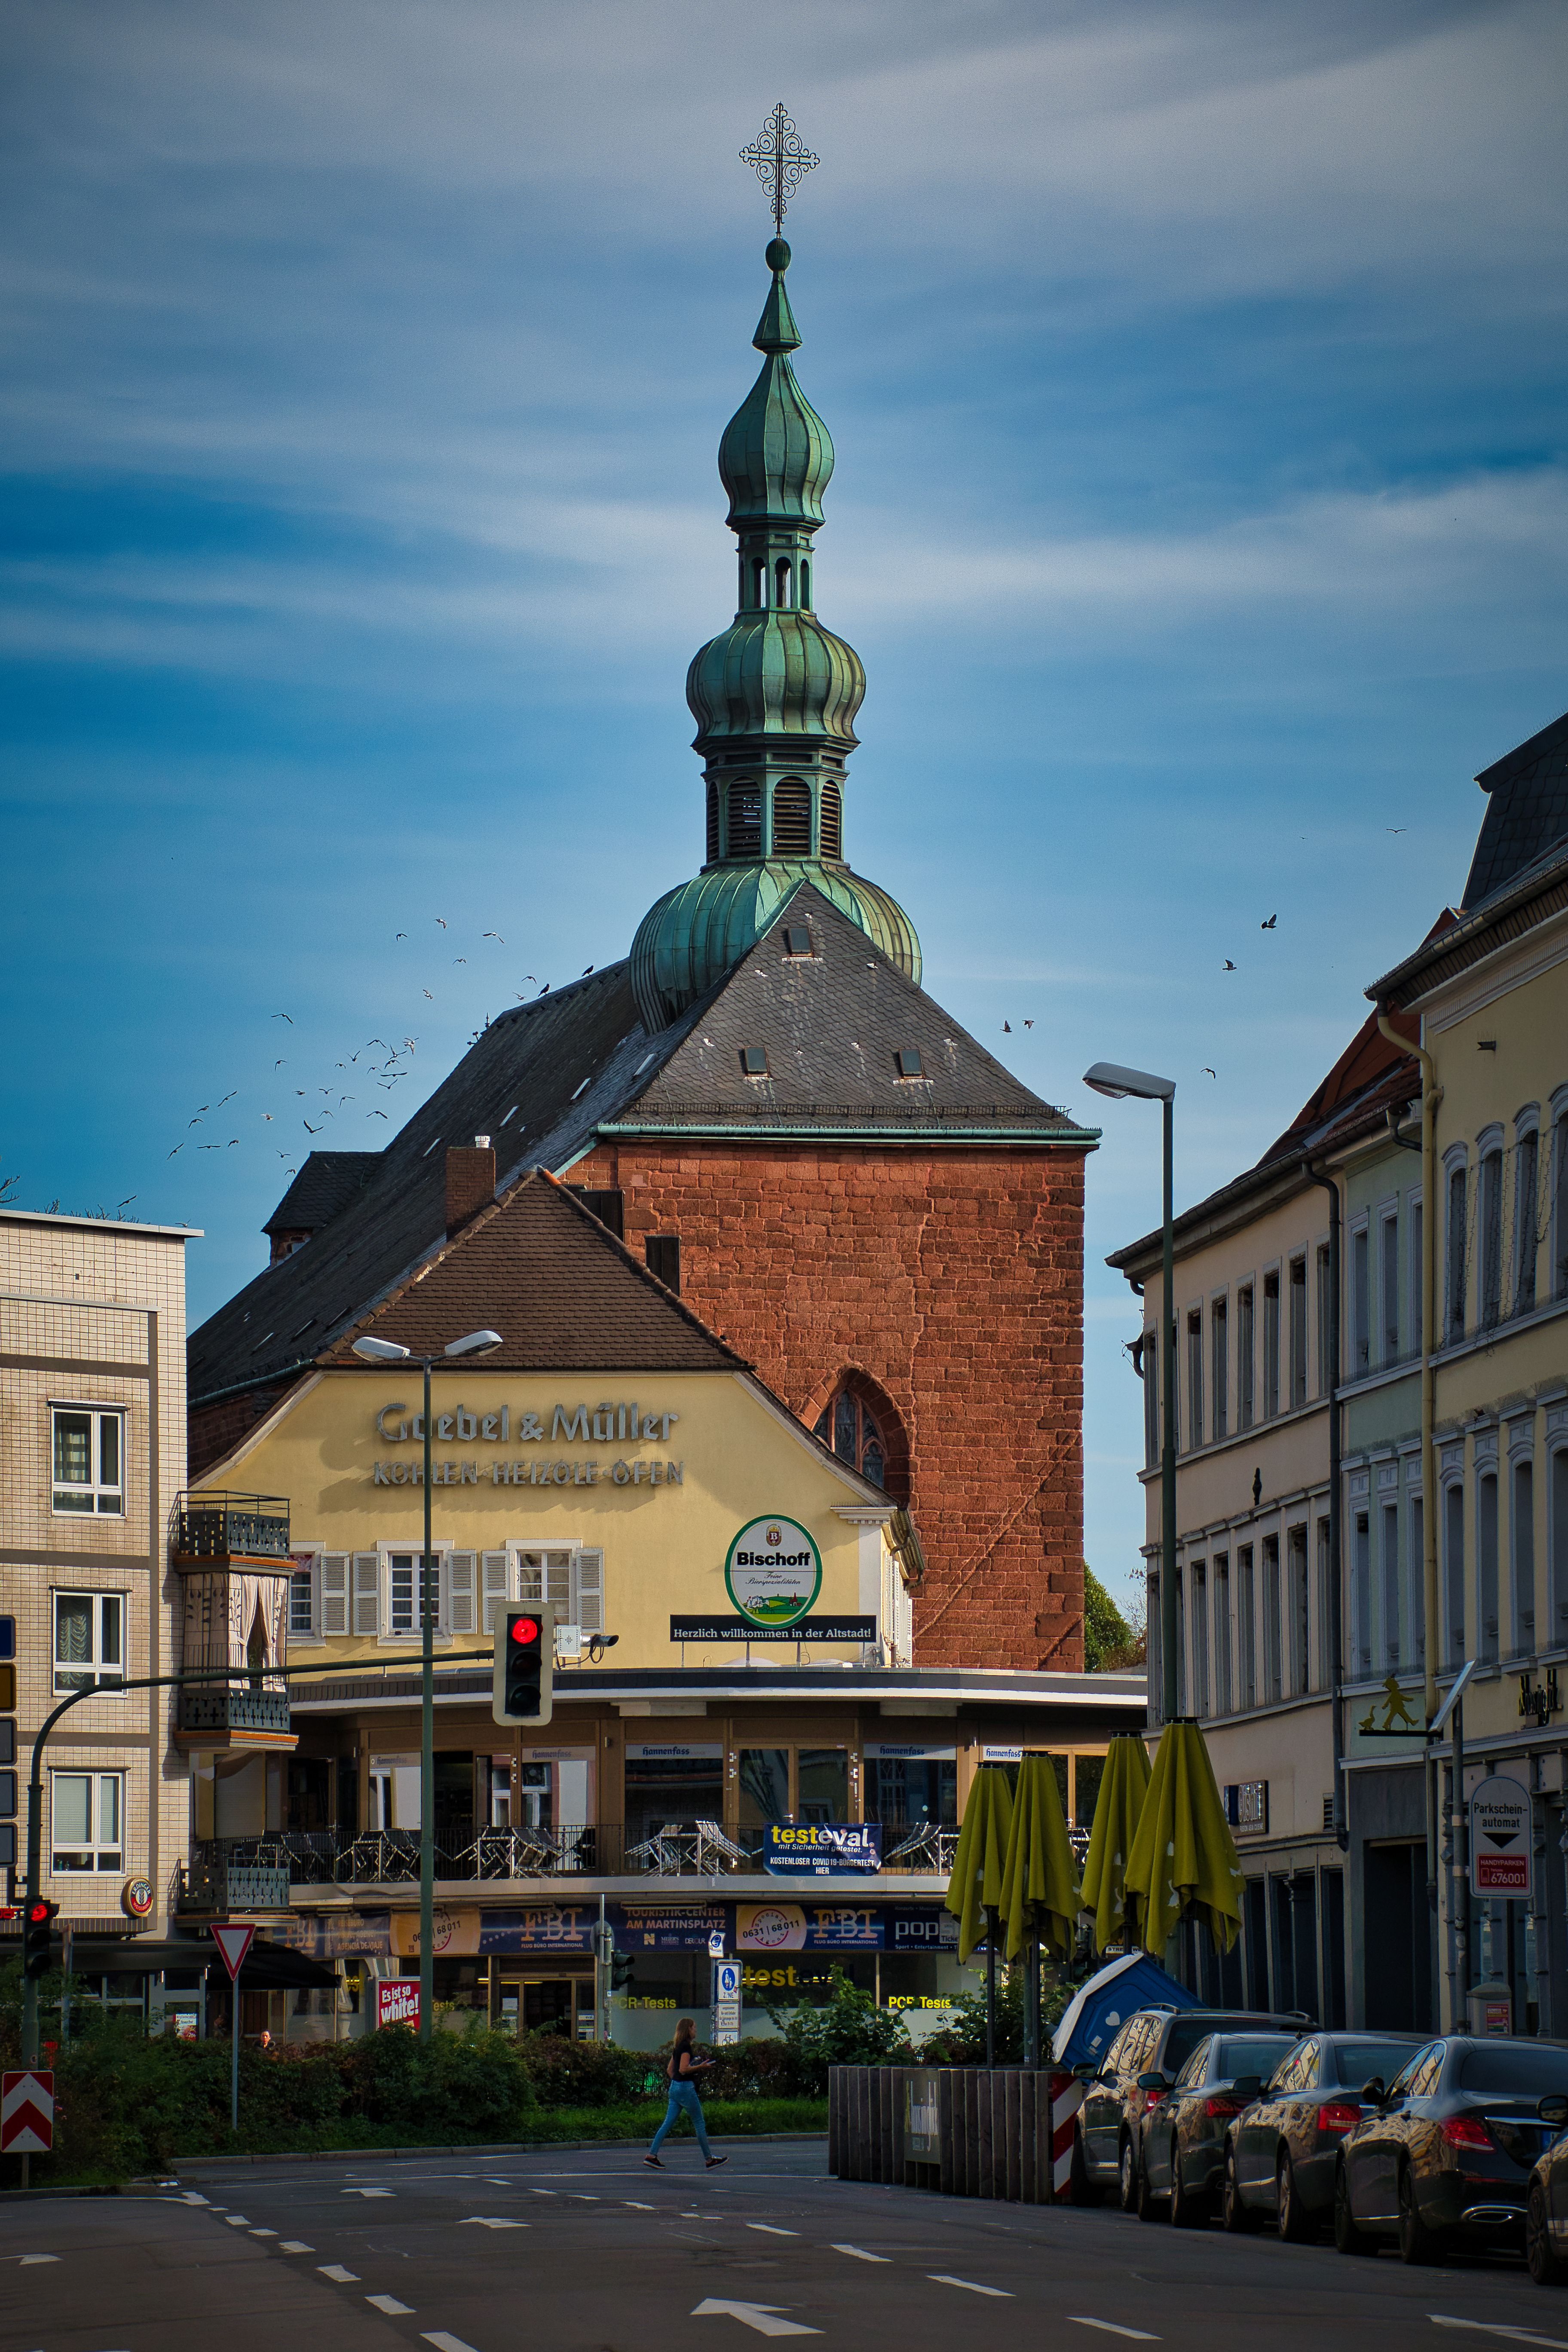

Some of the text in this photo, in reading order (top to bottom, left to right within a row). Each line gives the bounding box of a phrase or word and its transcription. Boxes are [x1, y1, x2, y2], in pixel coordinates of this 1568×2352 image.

[377, 1403, 678, 1441] Goebel & Müller
[374, 1461, 477, 1484] KOHLEN
[737, 1552, 810, 1565] Bischoff
[745, 1577, 801, 1586] Bierspezialitäten
[674, 1629, 871, 1637] Herzlich willkommen in der Altstadt!
[1474, 1803, 1527, 1814] Parkschein-
[1482, 1817, 1520, 1827] automat
[771, 1857, 810, 1865] KOSTENLOSER
[1491, 1873, 1525, 1883] 676001
[132, 1883, 150, 1895] ERDINGER
[627, 1908, 725, 1917] TOURISTIK-CENTER
[521, 1908, 583, 1941] FBI
[626, 1920, 726, 1929] AM MARTINSPLATZ
[743, 1928, 764, 1938] 0631
[772, 1923, 782, 1932] 68
[784, 1920, 799, 1929] 011
[813, 1909, 878, 1938] FBI
[382, 1985, 410, 2003] Es ist so
[381, 1993, 419, 2024] white!
